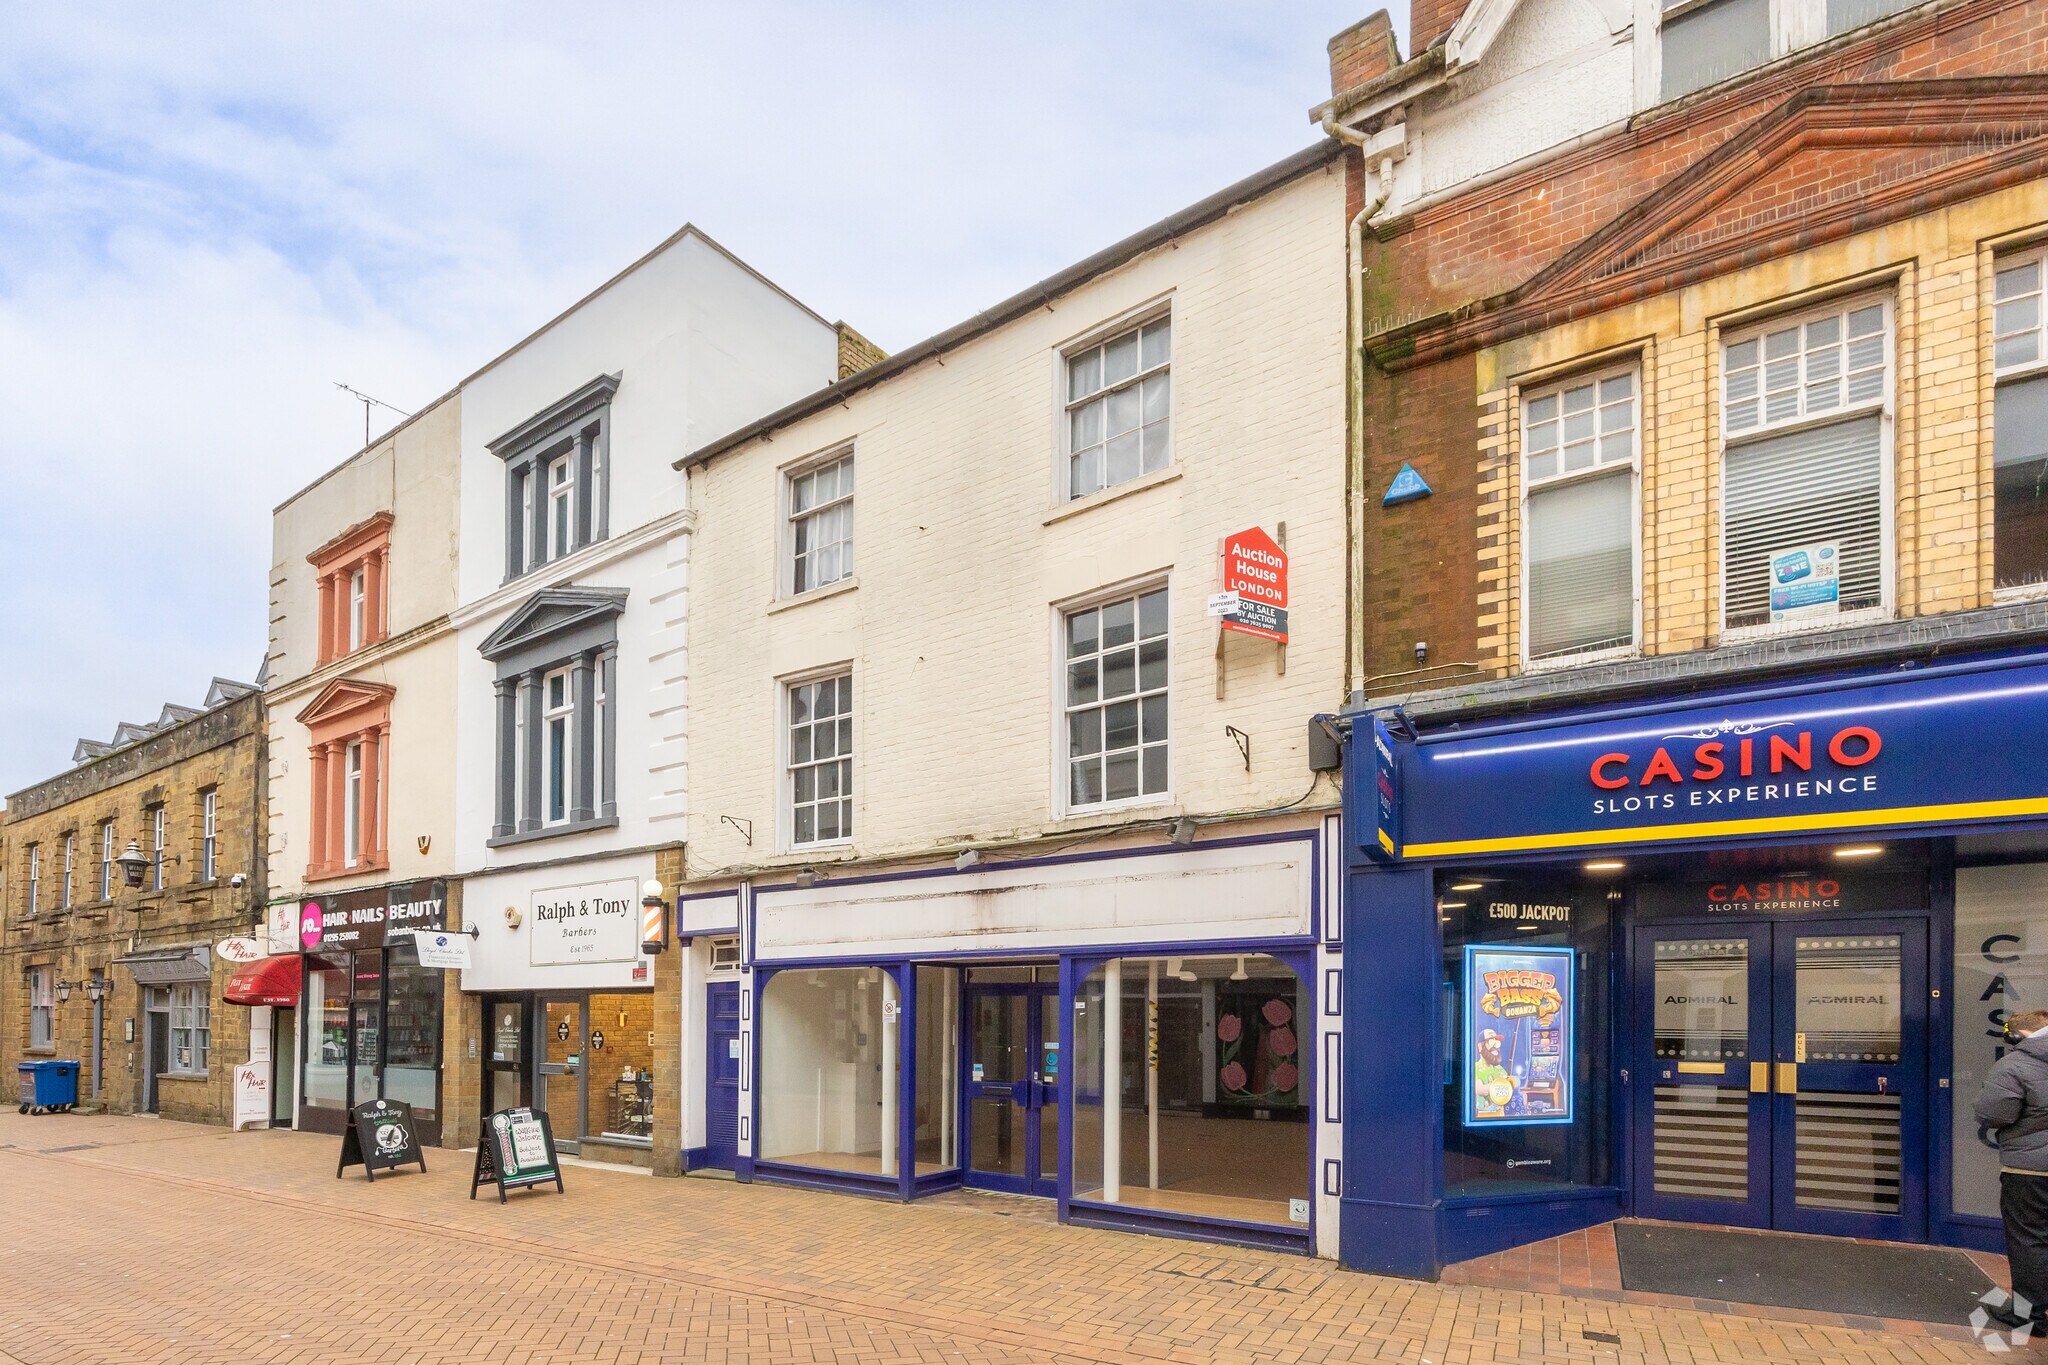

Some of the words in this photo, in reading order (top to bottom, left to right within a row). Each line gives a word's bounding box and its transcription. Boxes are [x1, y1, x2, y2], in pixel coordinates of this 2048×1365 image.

[1391, 484, 1420, 496] Chubb
[1232, 543, 1283, 568] Auction
[1237, 560, 1277, 582] House
[1777, 561, 1808, 577] ZONE
[1231, 578, 1282, 601] LONDON
[1238, 600, 1254, 611] FOR
[1257, 605, 1276, 617] SALE
[1237, 610, 1246, 618] BY
[1247, 612, 1277, 625] AUCTION
[1590, 726, 1882, 790] CASINO
[1593, 793, 1675, 814] SLOTS
[1690, 775, 1878, 806] EXPERIENCE
[1707, 880, 1840, 902] CASINO
[322, 911, 348, 928] HAIR
[352, 906, 384, 924] NAILS
[389, 898, 442, 920] BEAUTY
[537, 900, 575, 924] Ralph
[579, 899, 589, 917] &
[593, 897, 630, 918] Tony
[1489, 903, 1517, 918] £500
[1519, 904, 1570, 921] JACKPOT
[1708, 903, 1748, 912] SLOTS
[1754, 899, 1840, 910] EXPERIENCE
[562, 926, 597, 938] Barbers
[581, 943, 594, 953] 1965
[1484, 970, 1556, 993] BIGGER
[1496, 987, 1543, 1007] BASS
[1664, 996, 1738, 1005] ADMIRAL
[1808, 995, 1890, 1005] ADMIRAL
[1505, 1004, 1537, 1017] BONANZA
[362, 1110, 381, 1119] Ralph
[388, 1109, 402, 1117] Tony
